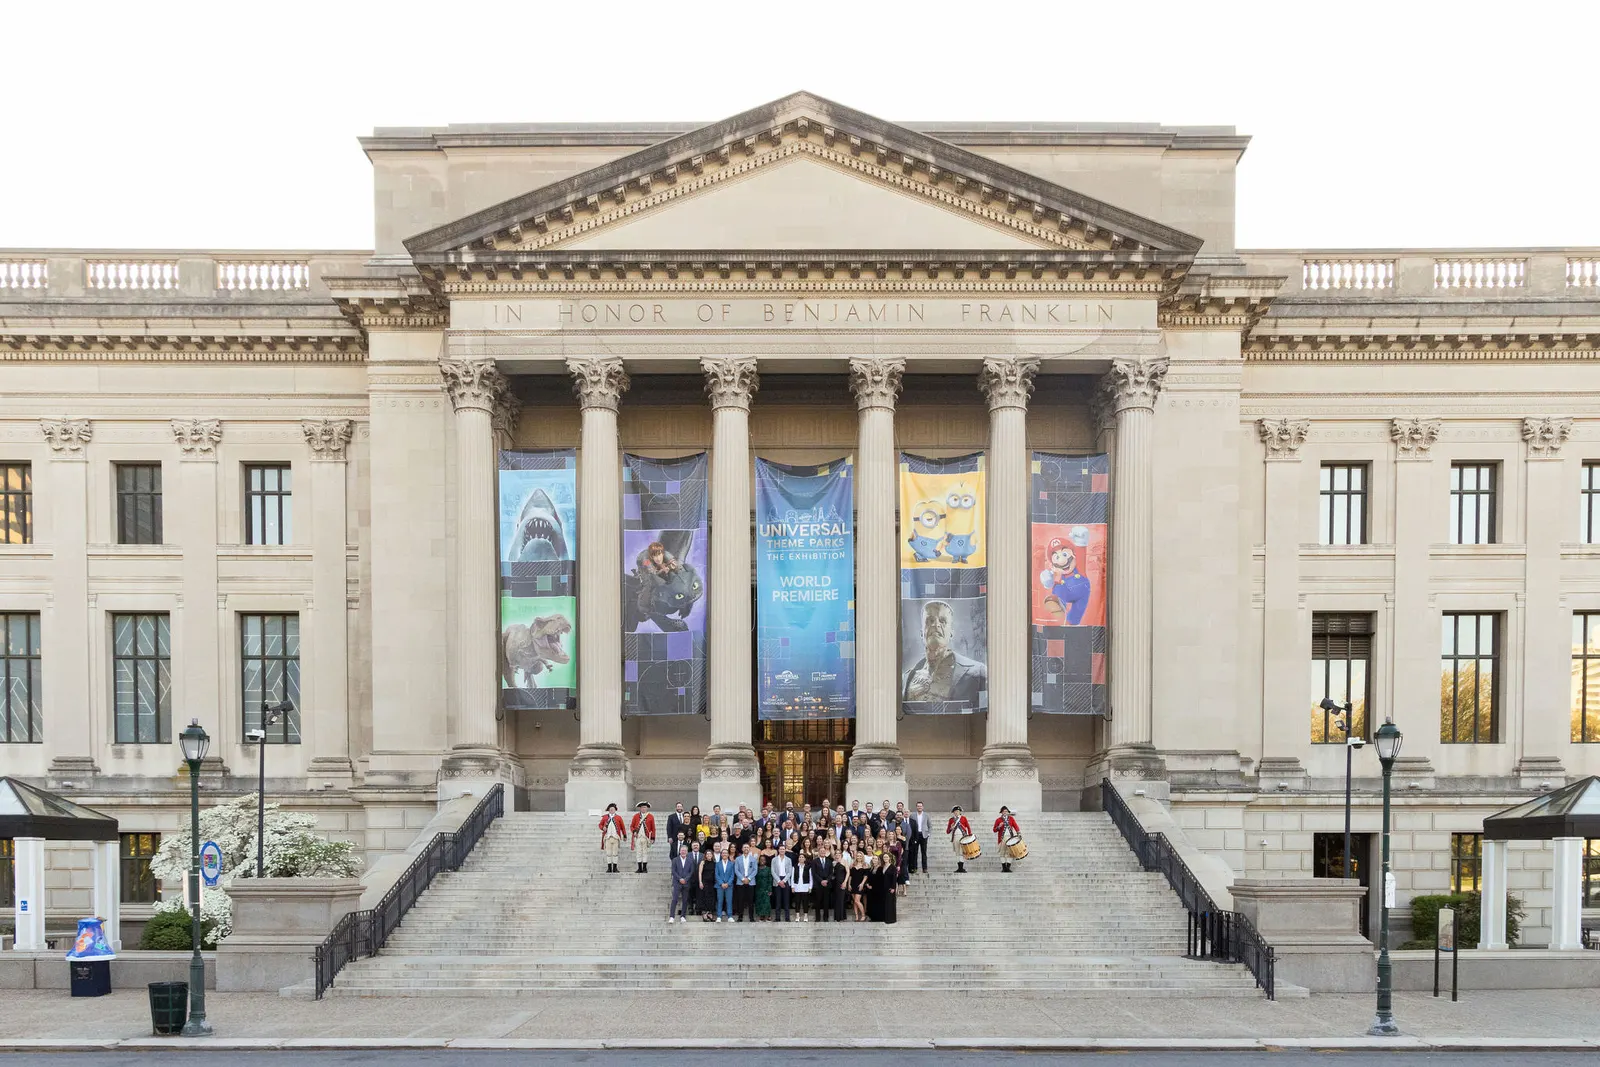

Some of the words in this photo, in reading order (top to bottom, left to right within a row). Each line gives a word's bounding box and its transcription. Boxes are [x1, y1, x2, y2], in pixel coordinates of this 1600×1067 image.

[493, 304, 522, 323] IN
[558, 304, 667, 323] HONOR
[697, 304, 732, 323] OF
[763, 304, 925, 323] BENJAMIN
[961, 304, 1114, 323] FRANKLIN
[760, 523, 850, 537] UNIVERSAL
[766, 539, 805, 548] THEME
[809, 538, 844, 547] PARKS
[789, 552, 845, 560] EXHIBITION
[780, 576, 831, 587] WORLD
[772, 589, 838, 602] PREMIERE
